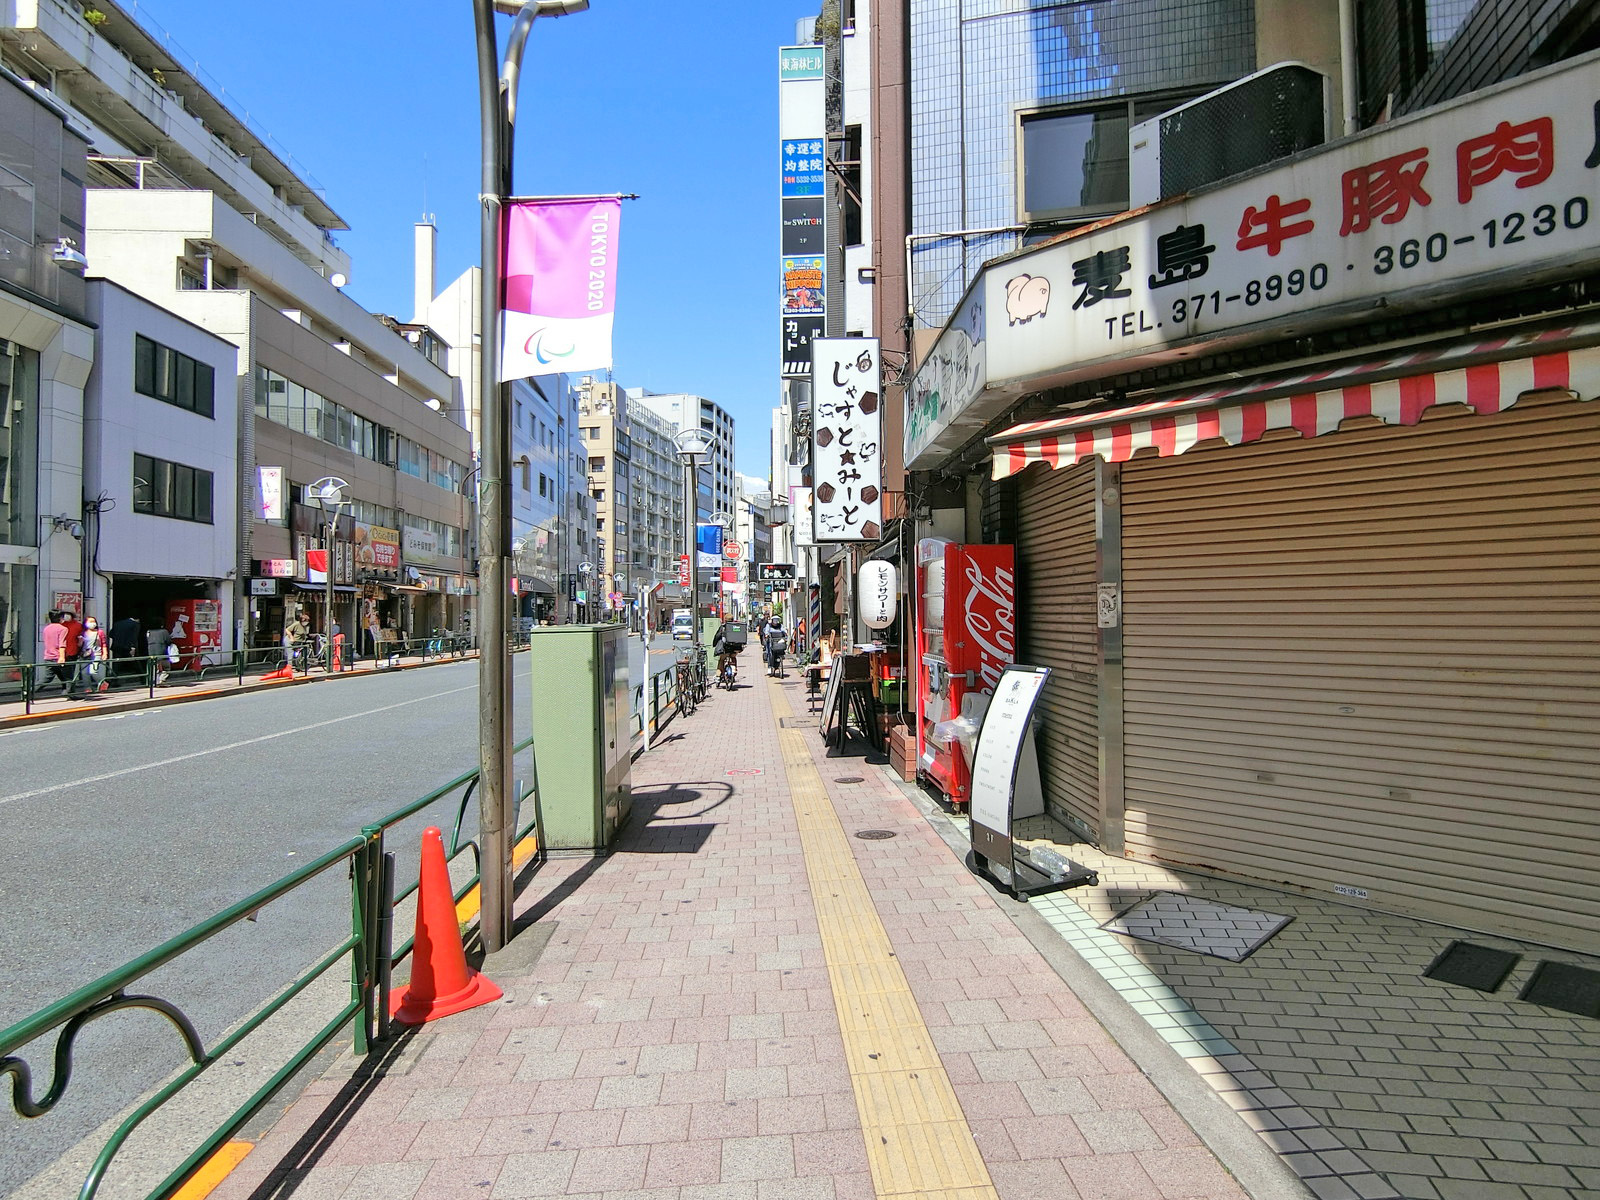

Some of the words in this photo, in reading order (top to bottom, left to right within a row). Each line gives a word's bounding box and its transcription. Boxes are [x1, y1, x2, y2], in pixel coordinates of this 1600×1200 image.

[782, 57, 822, 71] 東海林ビル
[784, 142, 822, 156] 幸運堂
[792, 218, 822, 226] SWITCH
[1072, 101, 1600, 310] 麦島牛豚肉
[589, 212, 609, 267] TOKYO
[1104, 311, 1163, 341] TEL.
[1171, 262, 1329, 325] 371-8990
[1373, 195, 1590, 276] 360-1230
[587, 270, 606, 311] 2020
[785, 320, 798, 351] カット
[56, 593, 81, 603] テナント
[876, 566, 889, 623] レモンサワーと肉
